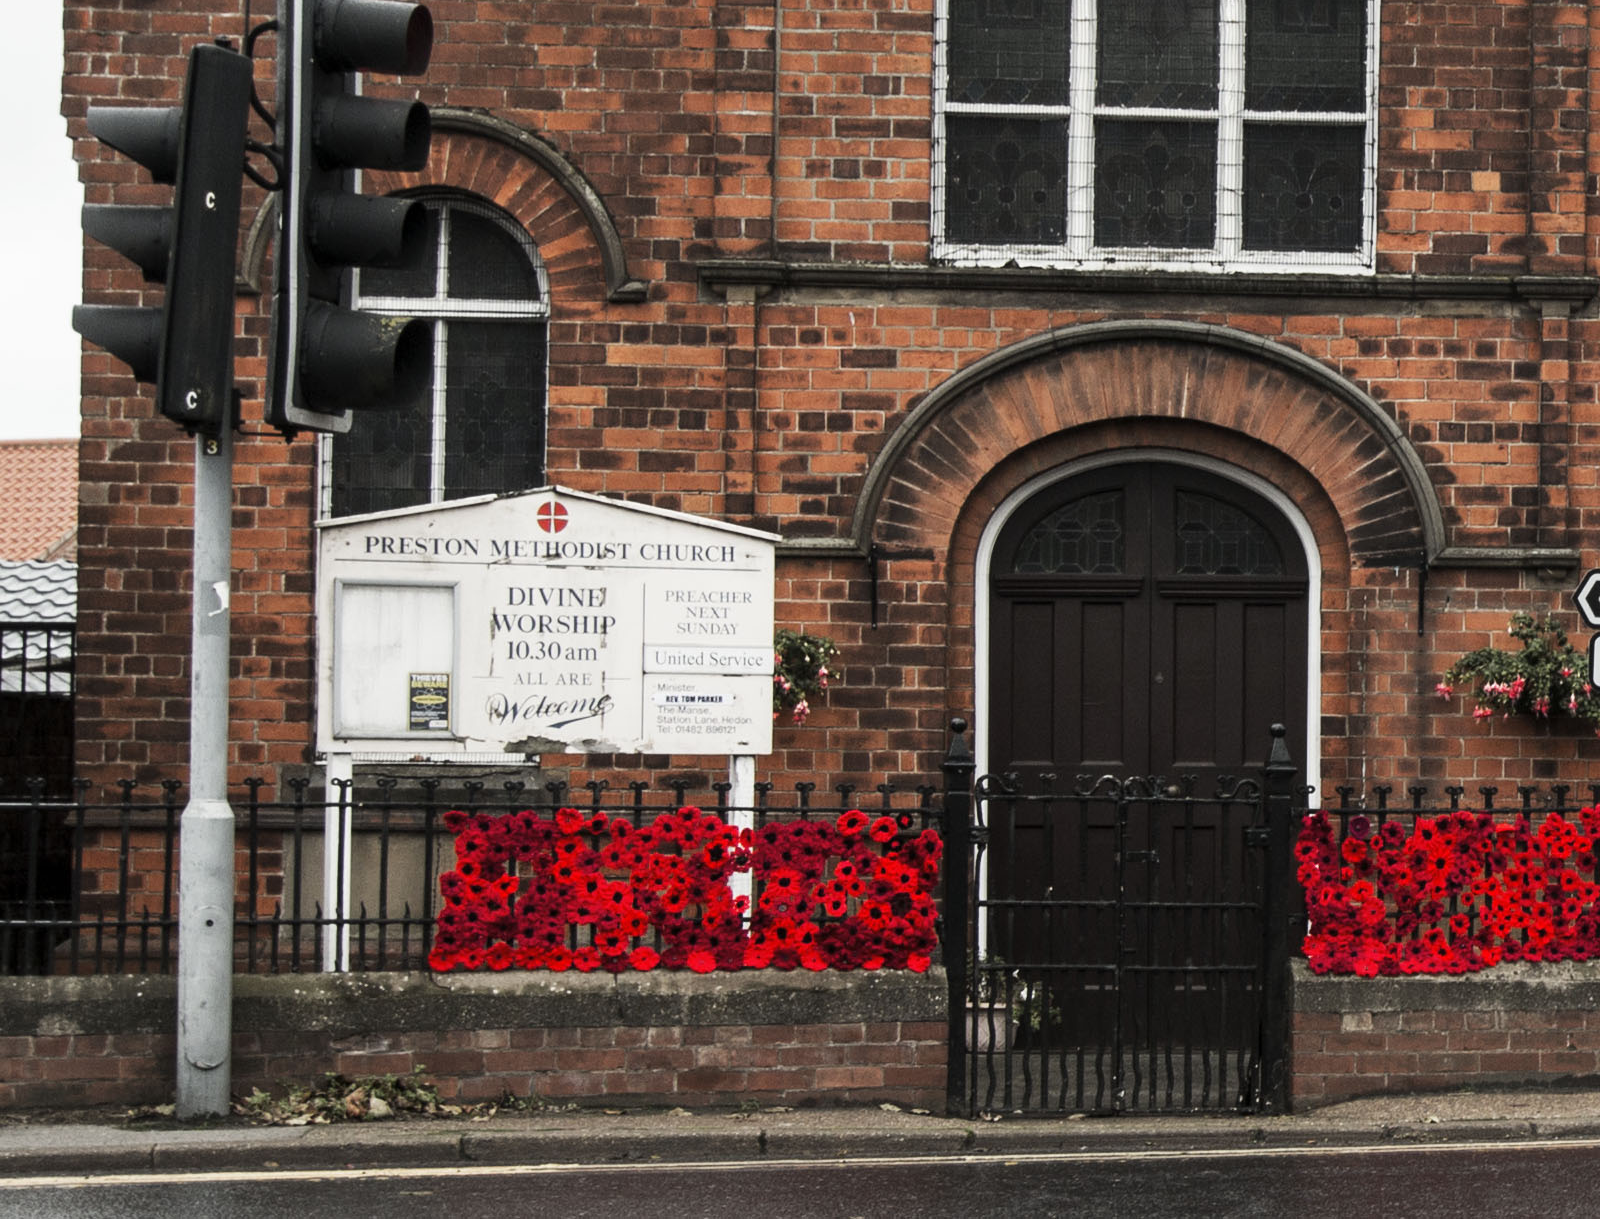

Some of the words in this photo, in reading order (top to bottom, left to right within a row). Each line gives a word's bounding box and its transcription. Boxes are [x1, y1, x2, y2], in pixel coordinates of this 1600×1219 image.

[205, 191, 216, 209] C
[186, 391, 198, 409] C
[207, 440, 218, 455] 3
[364, 535, 479, 556] PRESTON
[490, 539, 632, 560] METHODIST
[639, 543, 735, 563] CHURCH
[507, 586, 604, 608] DIVINE
[665, 590, 752, 604] PREACHER
[686, 606, 731, 619] NEXT
[492, 613, 616, 635] WORSHIP
[677, 622, 738, 636] SUNDAY
[507, 640, 562, 661] 10.30
[565, 646, 598, 661] am
[656, 651, 704, 666] United
[709, 652, 763, 667] Service
[513, 672, 548, 686] ALL
[555, 673, 593, 686] ARE
[682, 695, 695, 703] TOM
[697, 696, 723, 704] PARKER
[485, 693, 615, 726] Welcome
[658, 706, 675, 715] The
[657, 715, 691, 725] Station
[675, 725, 702, 735] 01482
